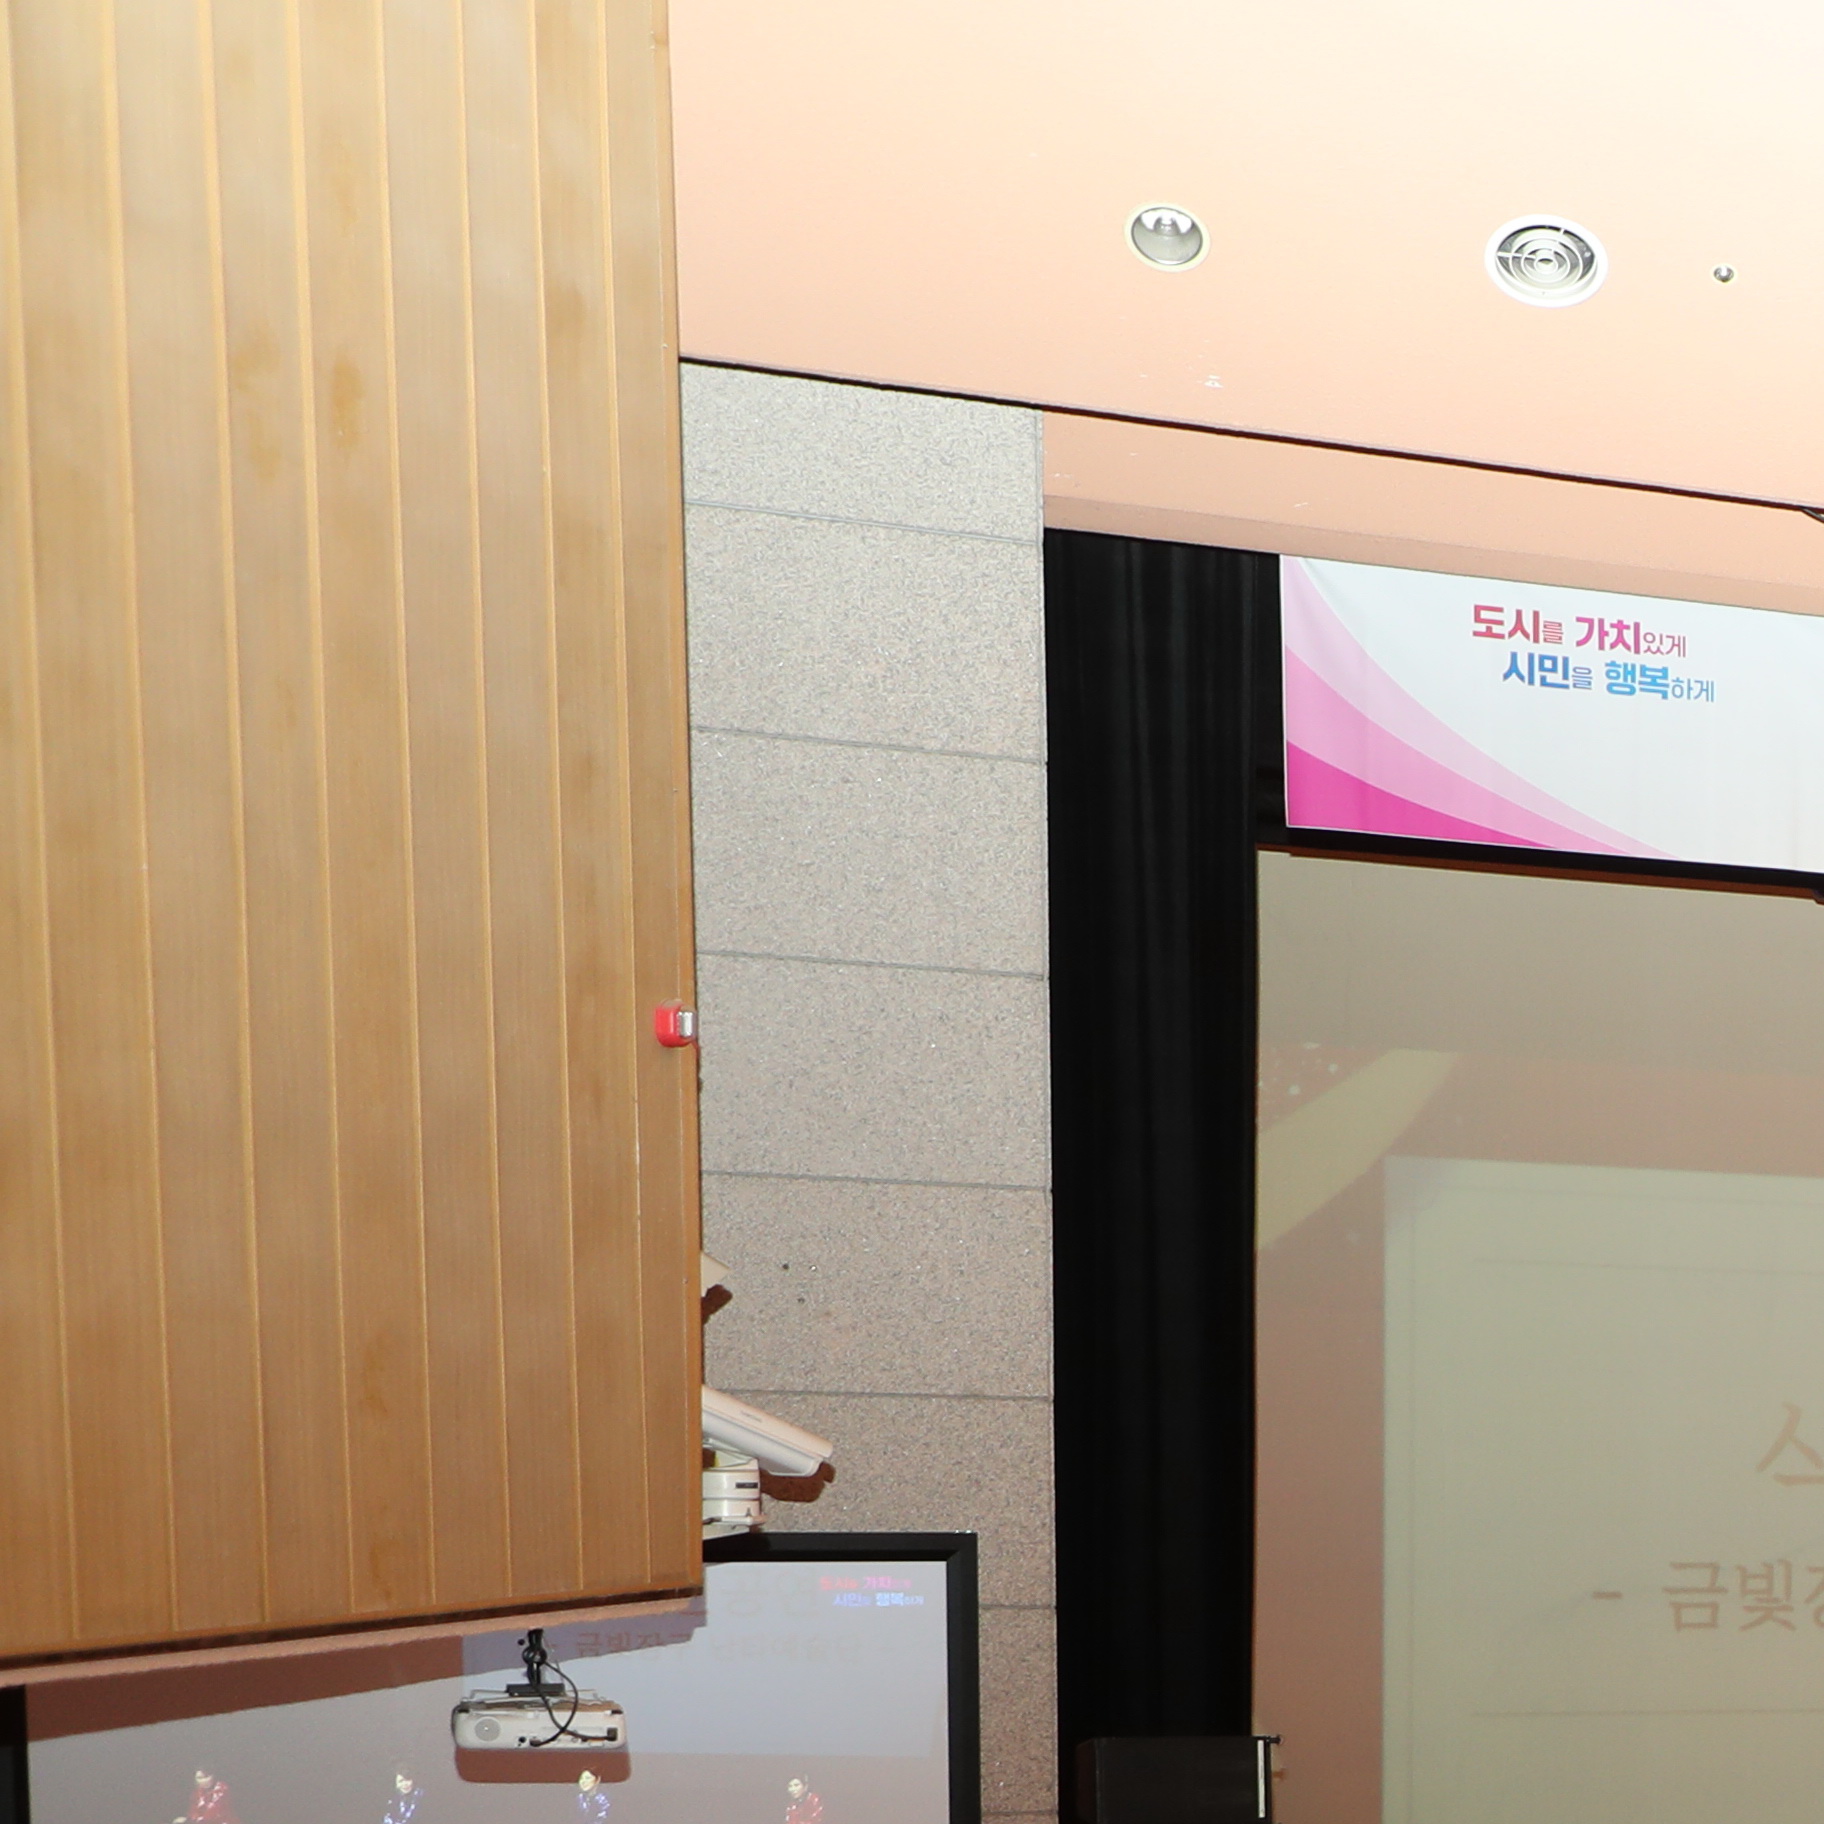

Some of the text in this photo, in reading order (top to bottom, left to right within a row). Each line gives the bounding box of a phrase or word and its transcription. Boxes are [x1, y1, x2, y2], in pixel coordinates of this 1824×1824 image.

[1472, 603, 1687, 658] 도시를 가치있게
[1502, 651, 1715, 703] 시민을 행복하게
